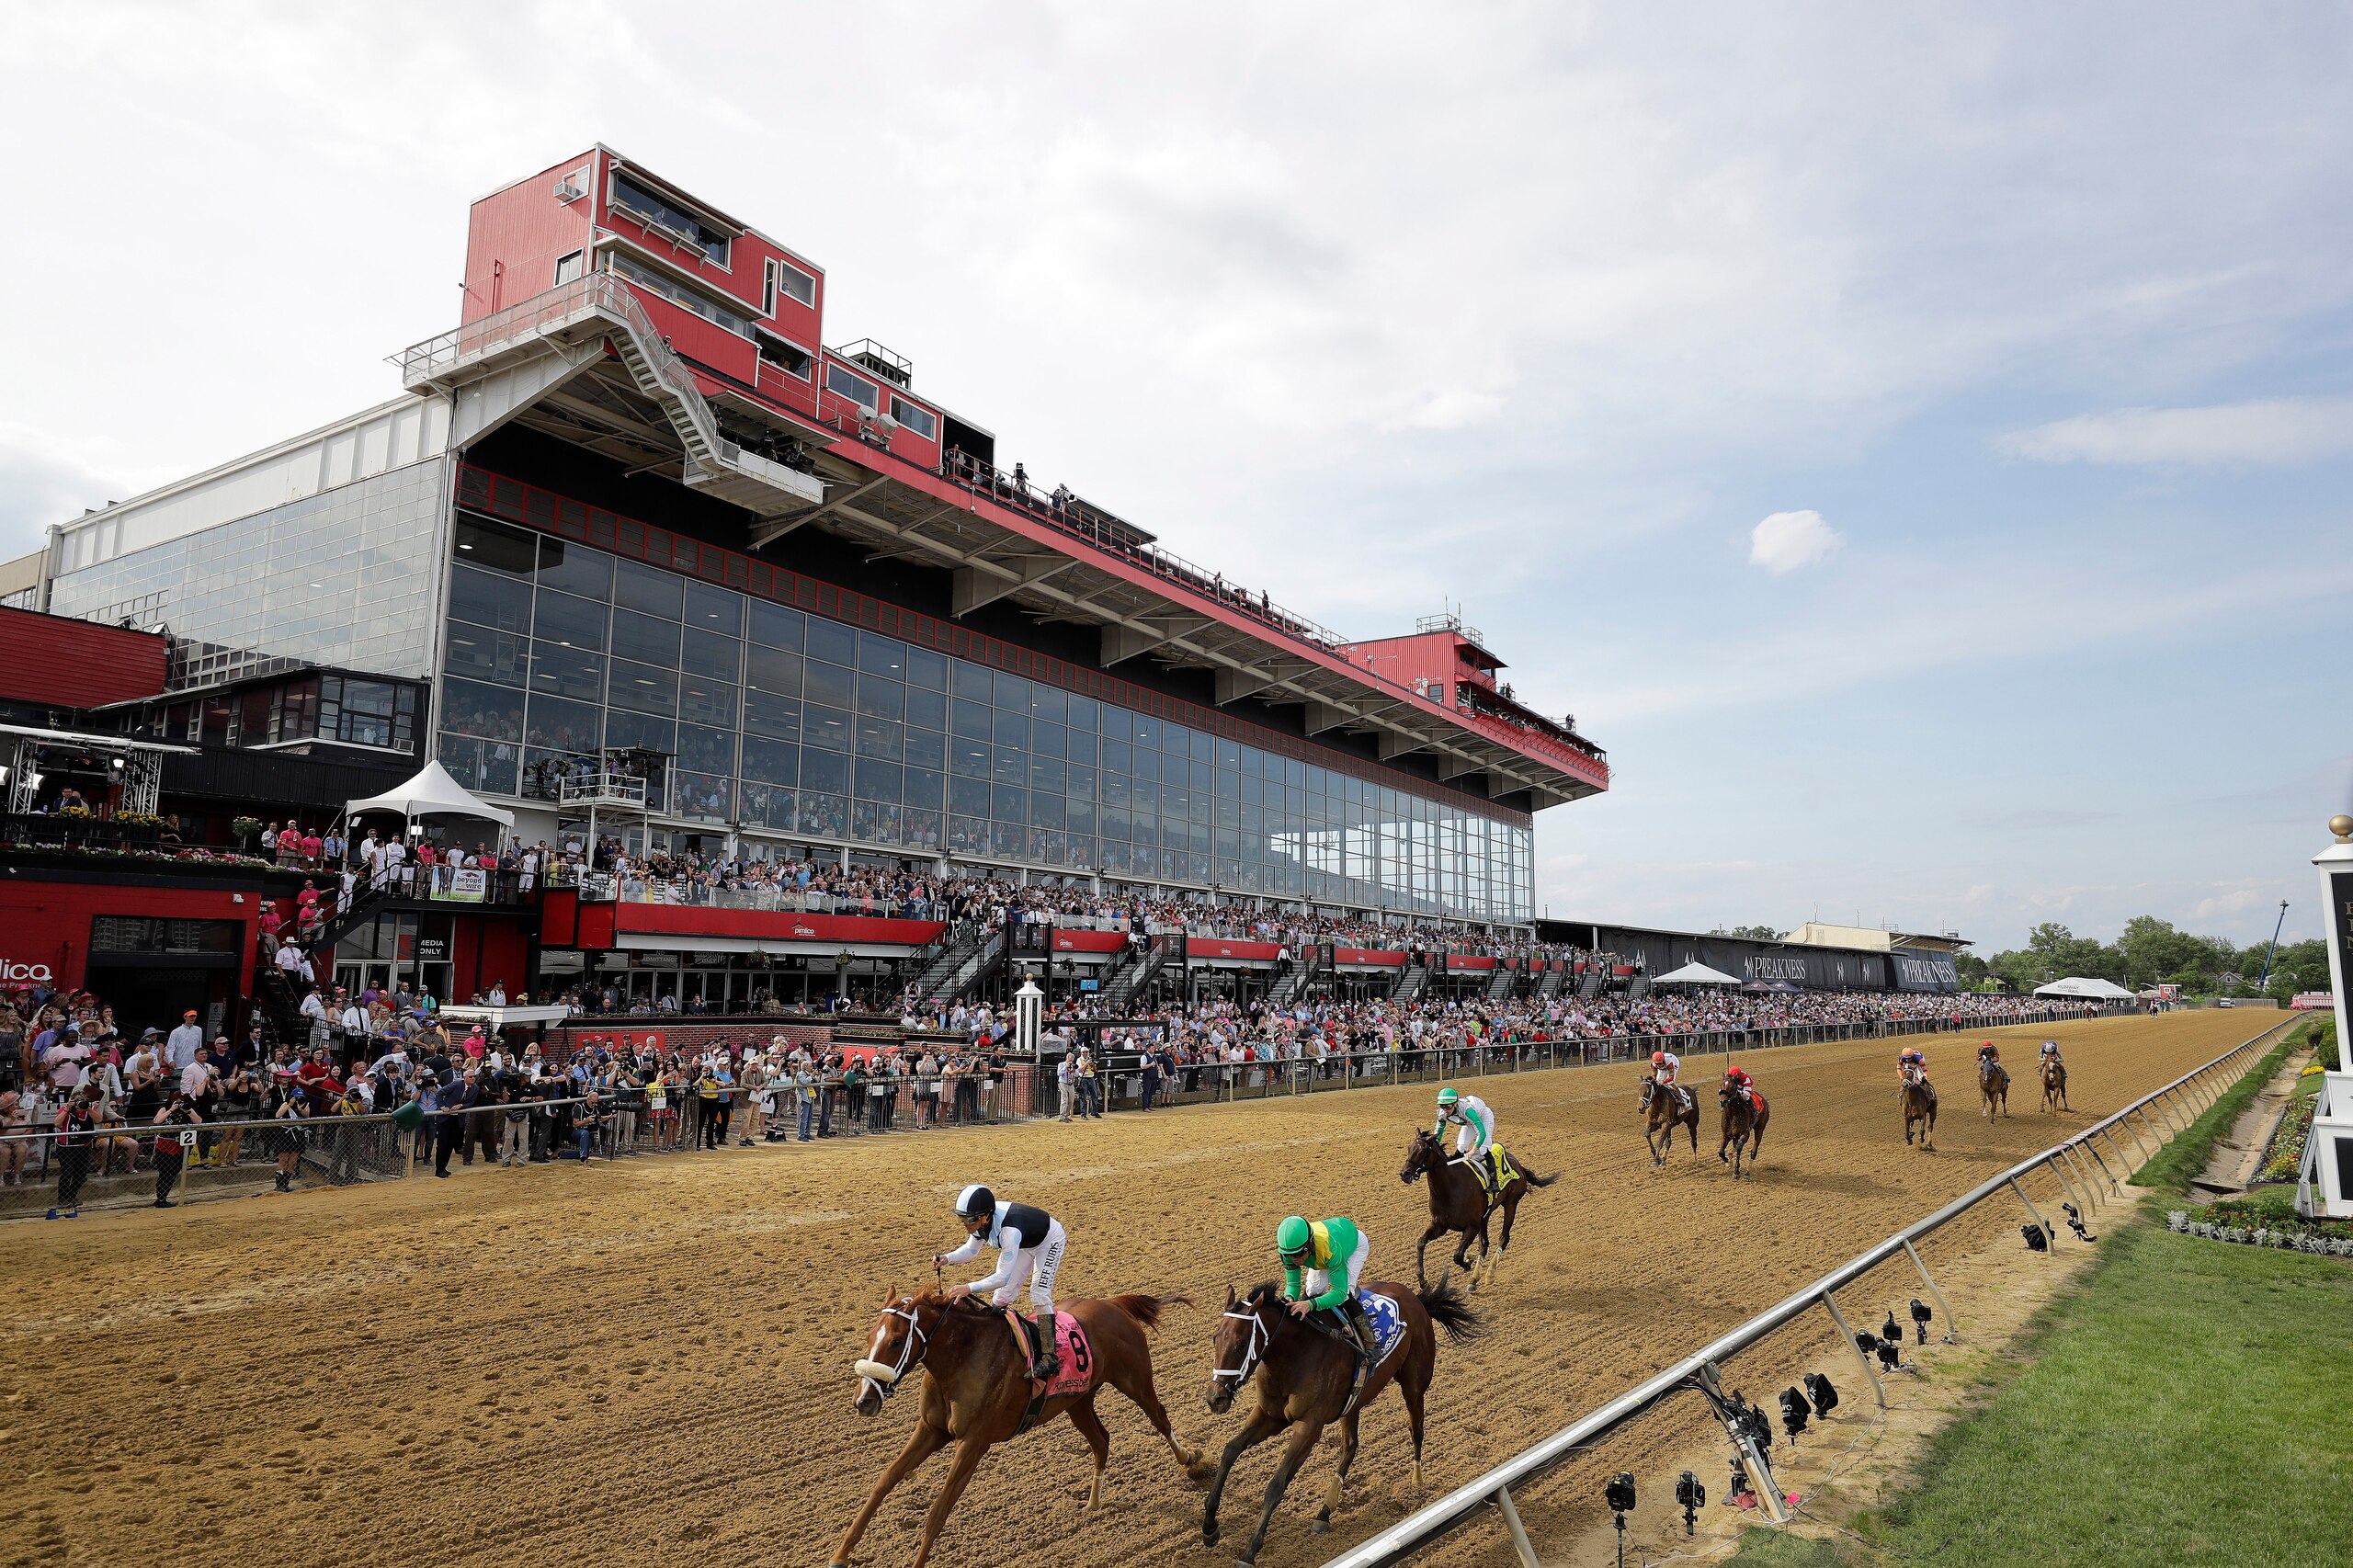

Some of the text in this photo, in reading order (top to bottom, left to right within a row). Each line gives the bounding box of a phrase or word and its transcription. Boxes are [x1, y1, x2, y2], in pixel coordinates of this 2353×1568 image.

[1755, 957, 1806, 980] PREAKNESS
[1907, 959, 1957, 983] PREAKNESS
[184, 1132, 193, 1144] 2
[1501, 1153, 1511, 1176] 4
[1038, 1268, 1051, 1289] JEFF
[1374, 1298, 1397, 1334] 3
[1069, 1331, 1089, 1372] 8
